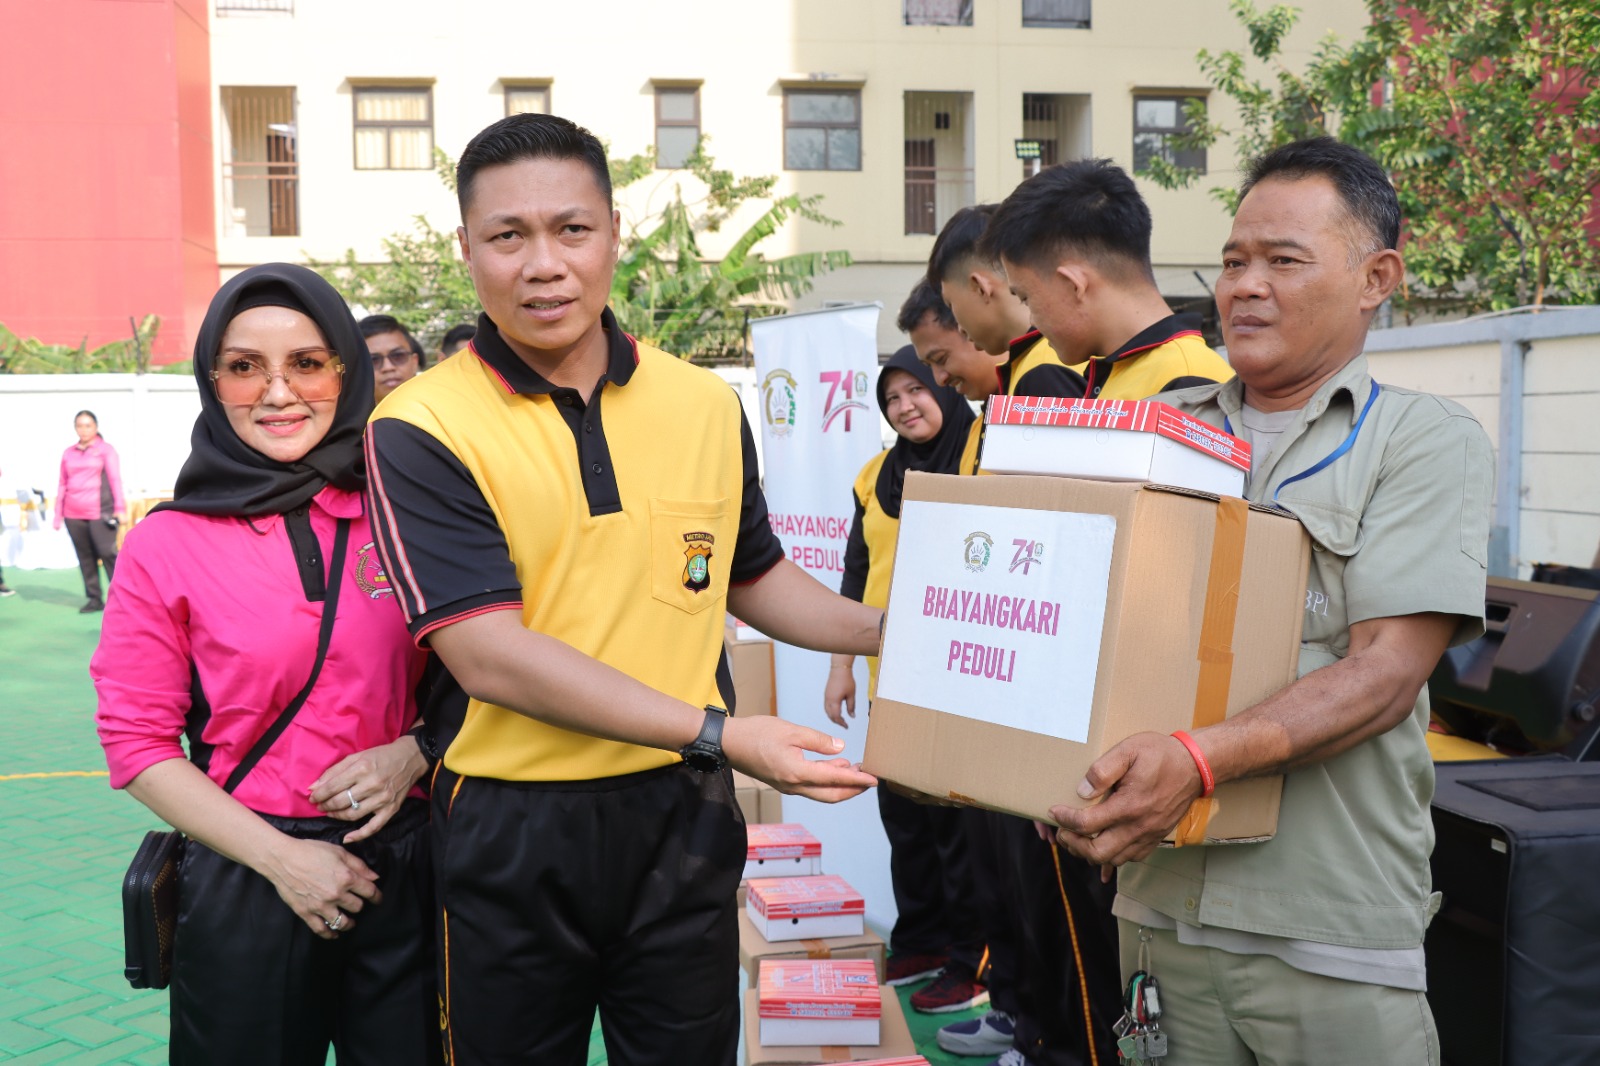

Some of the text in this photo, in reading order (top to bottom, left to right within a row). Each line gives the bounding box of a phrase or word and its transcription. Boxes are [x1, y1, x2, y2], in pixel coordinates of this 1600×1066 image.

[820, 370, 853, 432] 71
[1011, 538, 1035, 576] 71
[923, 585, 1061, 636] BHAYANGKARI
[947, 639, 1016, 683] PEDULI
